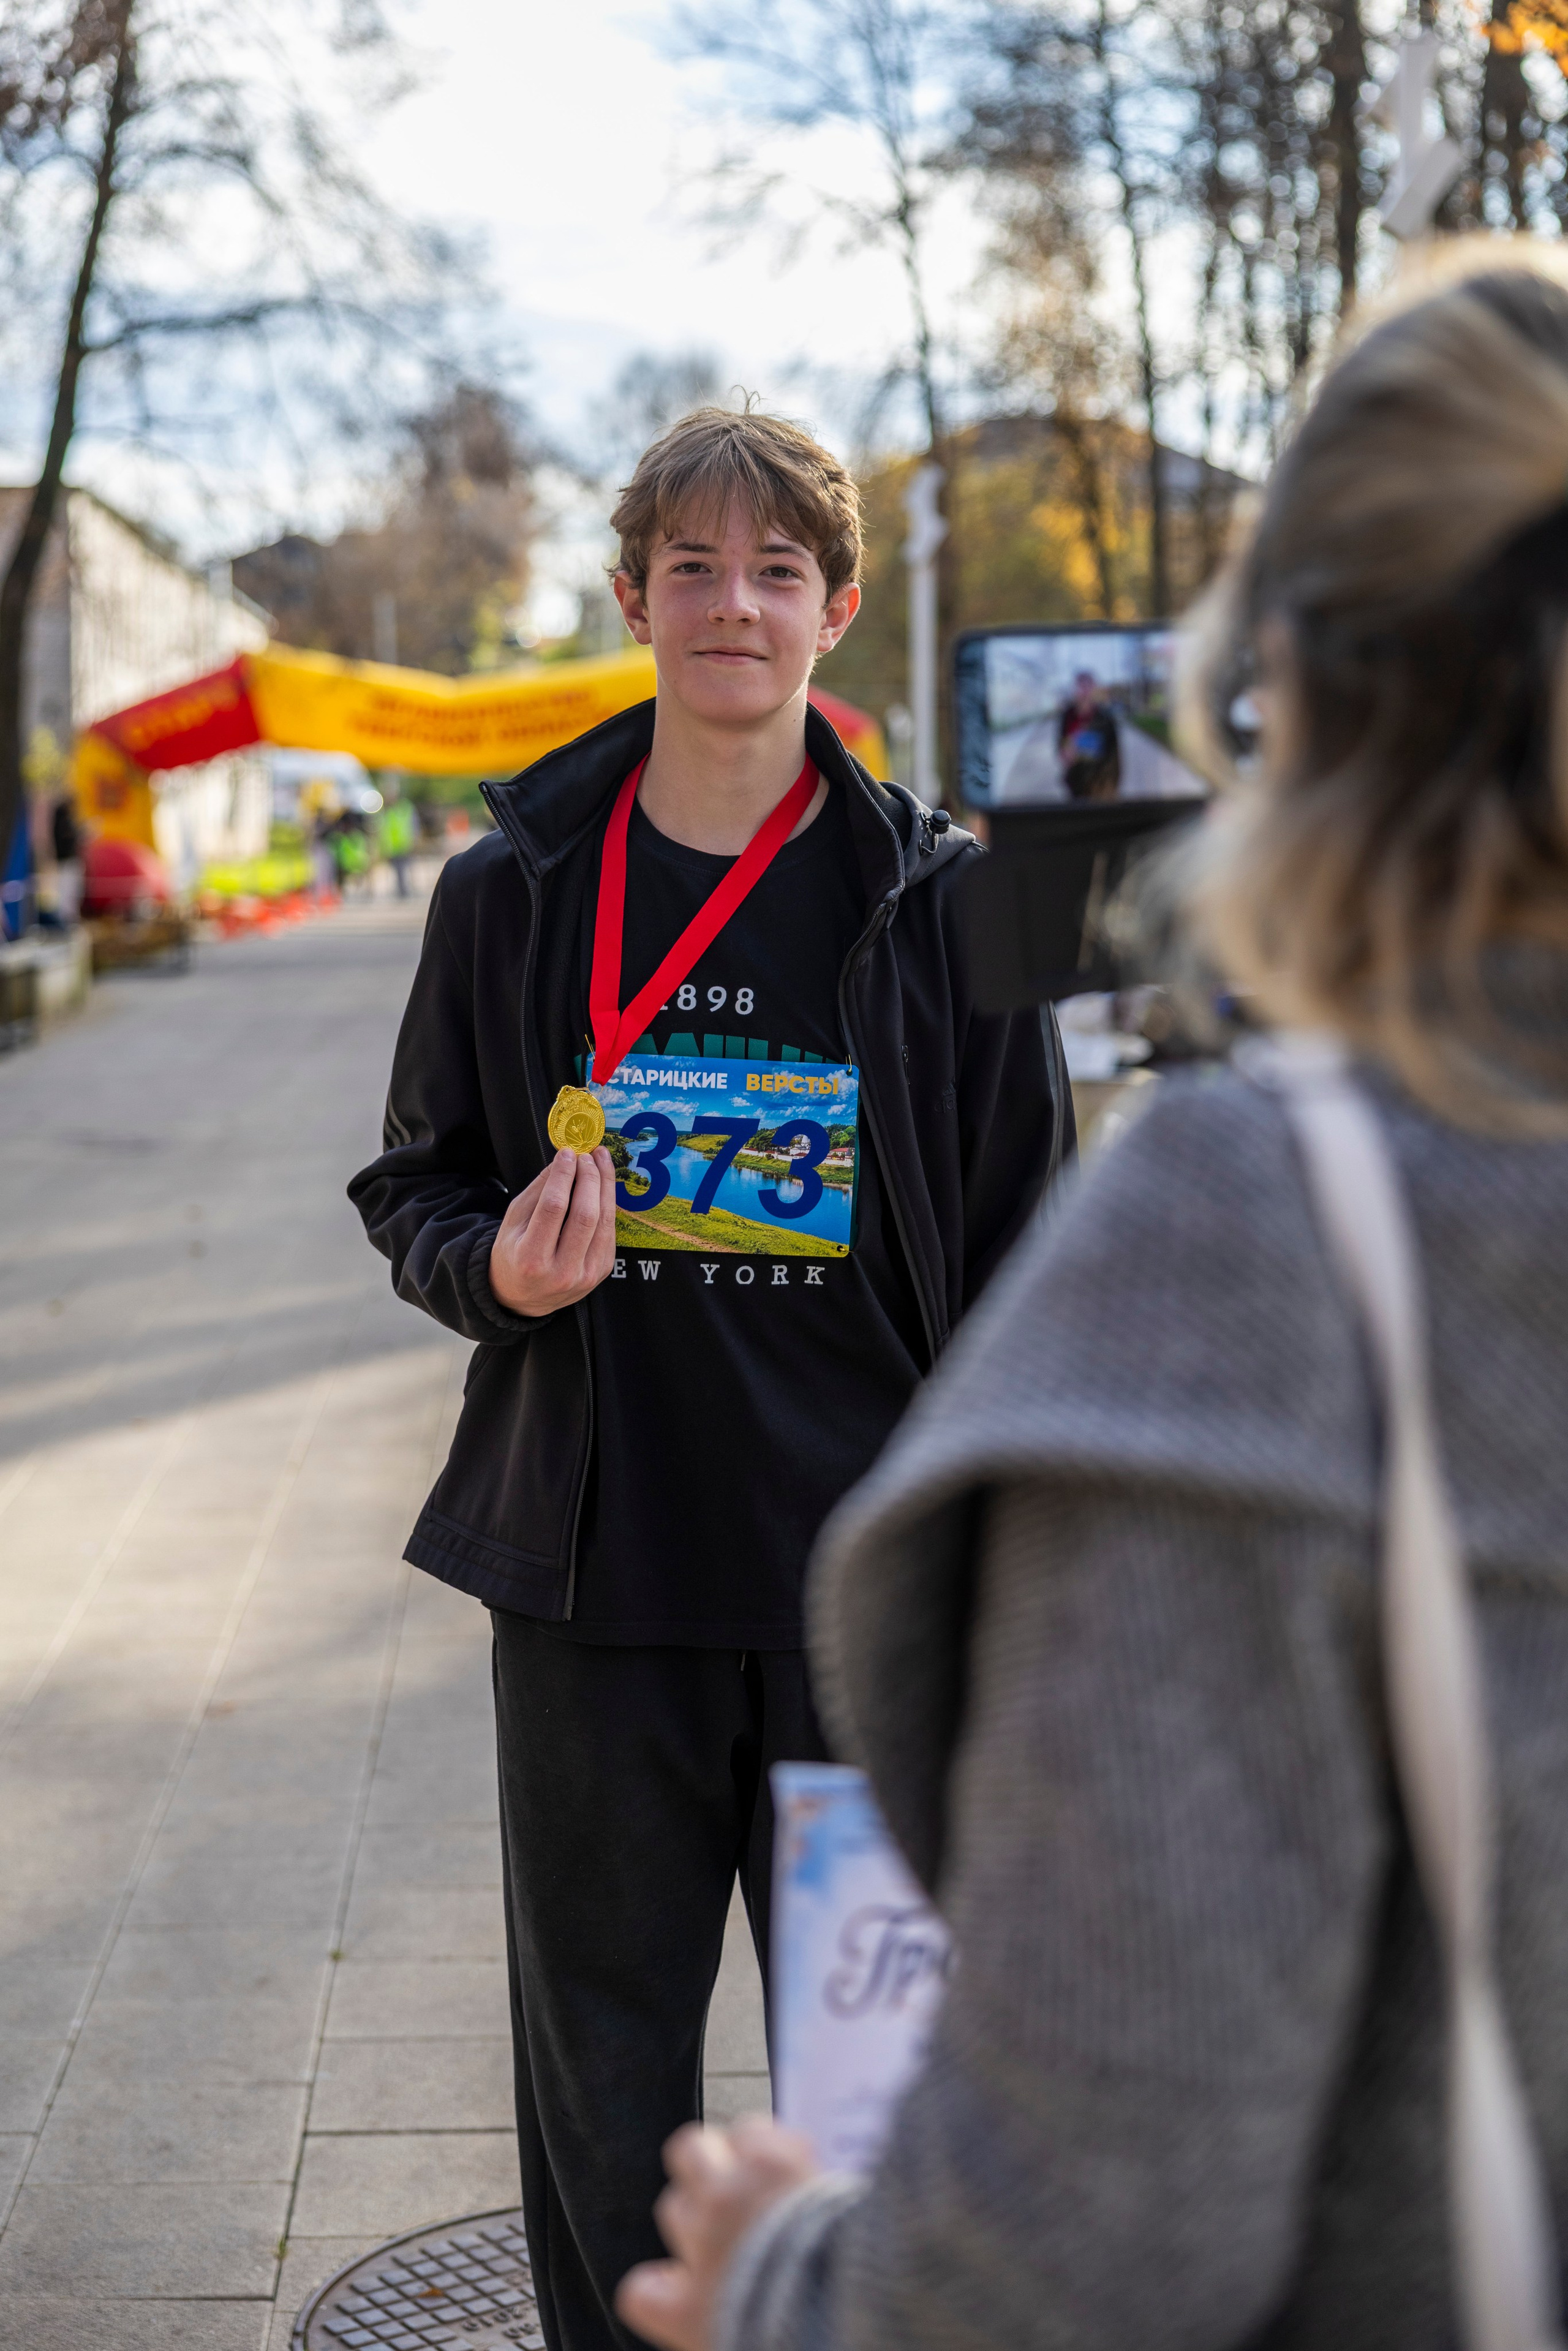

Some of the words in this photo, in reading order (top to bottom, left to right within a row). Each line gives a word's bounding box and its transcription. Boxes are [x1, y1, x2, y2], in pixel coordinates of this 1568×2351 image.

[660, 984, 754, 1015] 898
[746, 1073, 839, 1095] ВЕРСТЫ
[616, 1112, 831, 1219] 373
[611, 1259, 661, 1280] EW
[700, 1264, 825, 1285] YORK
